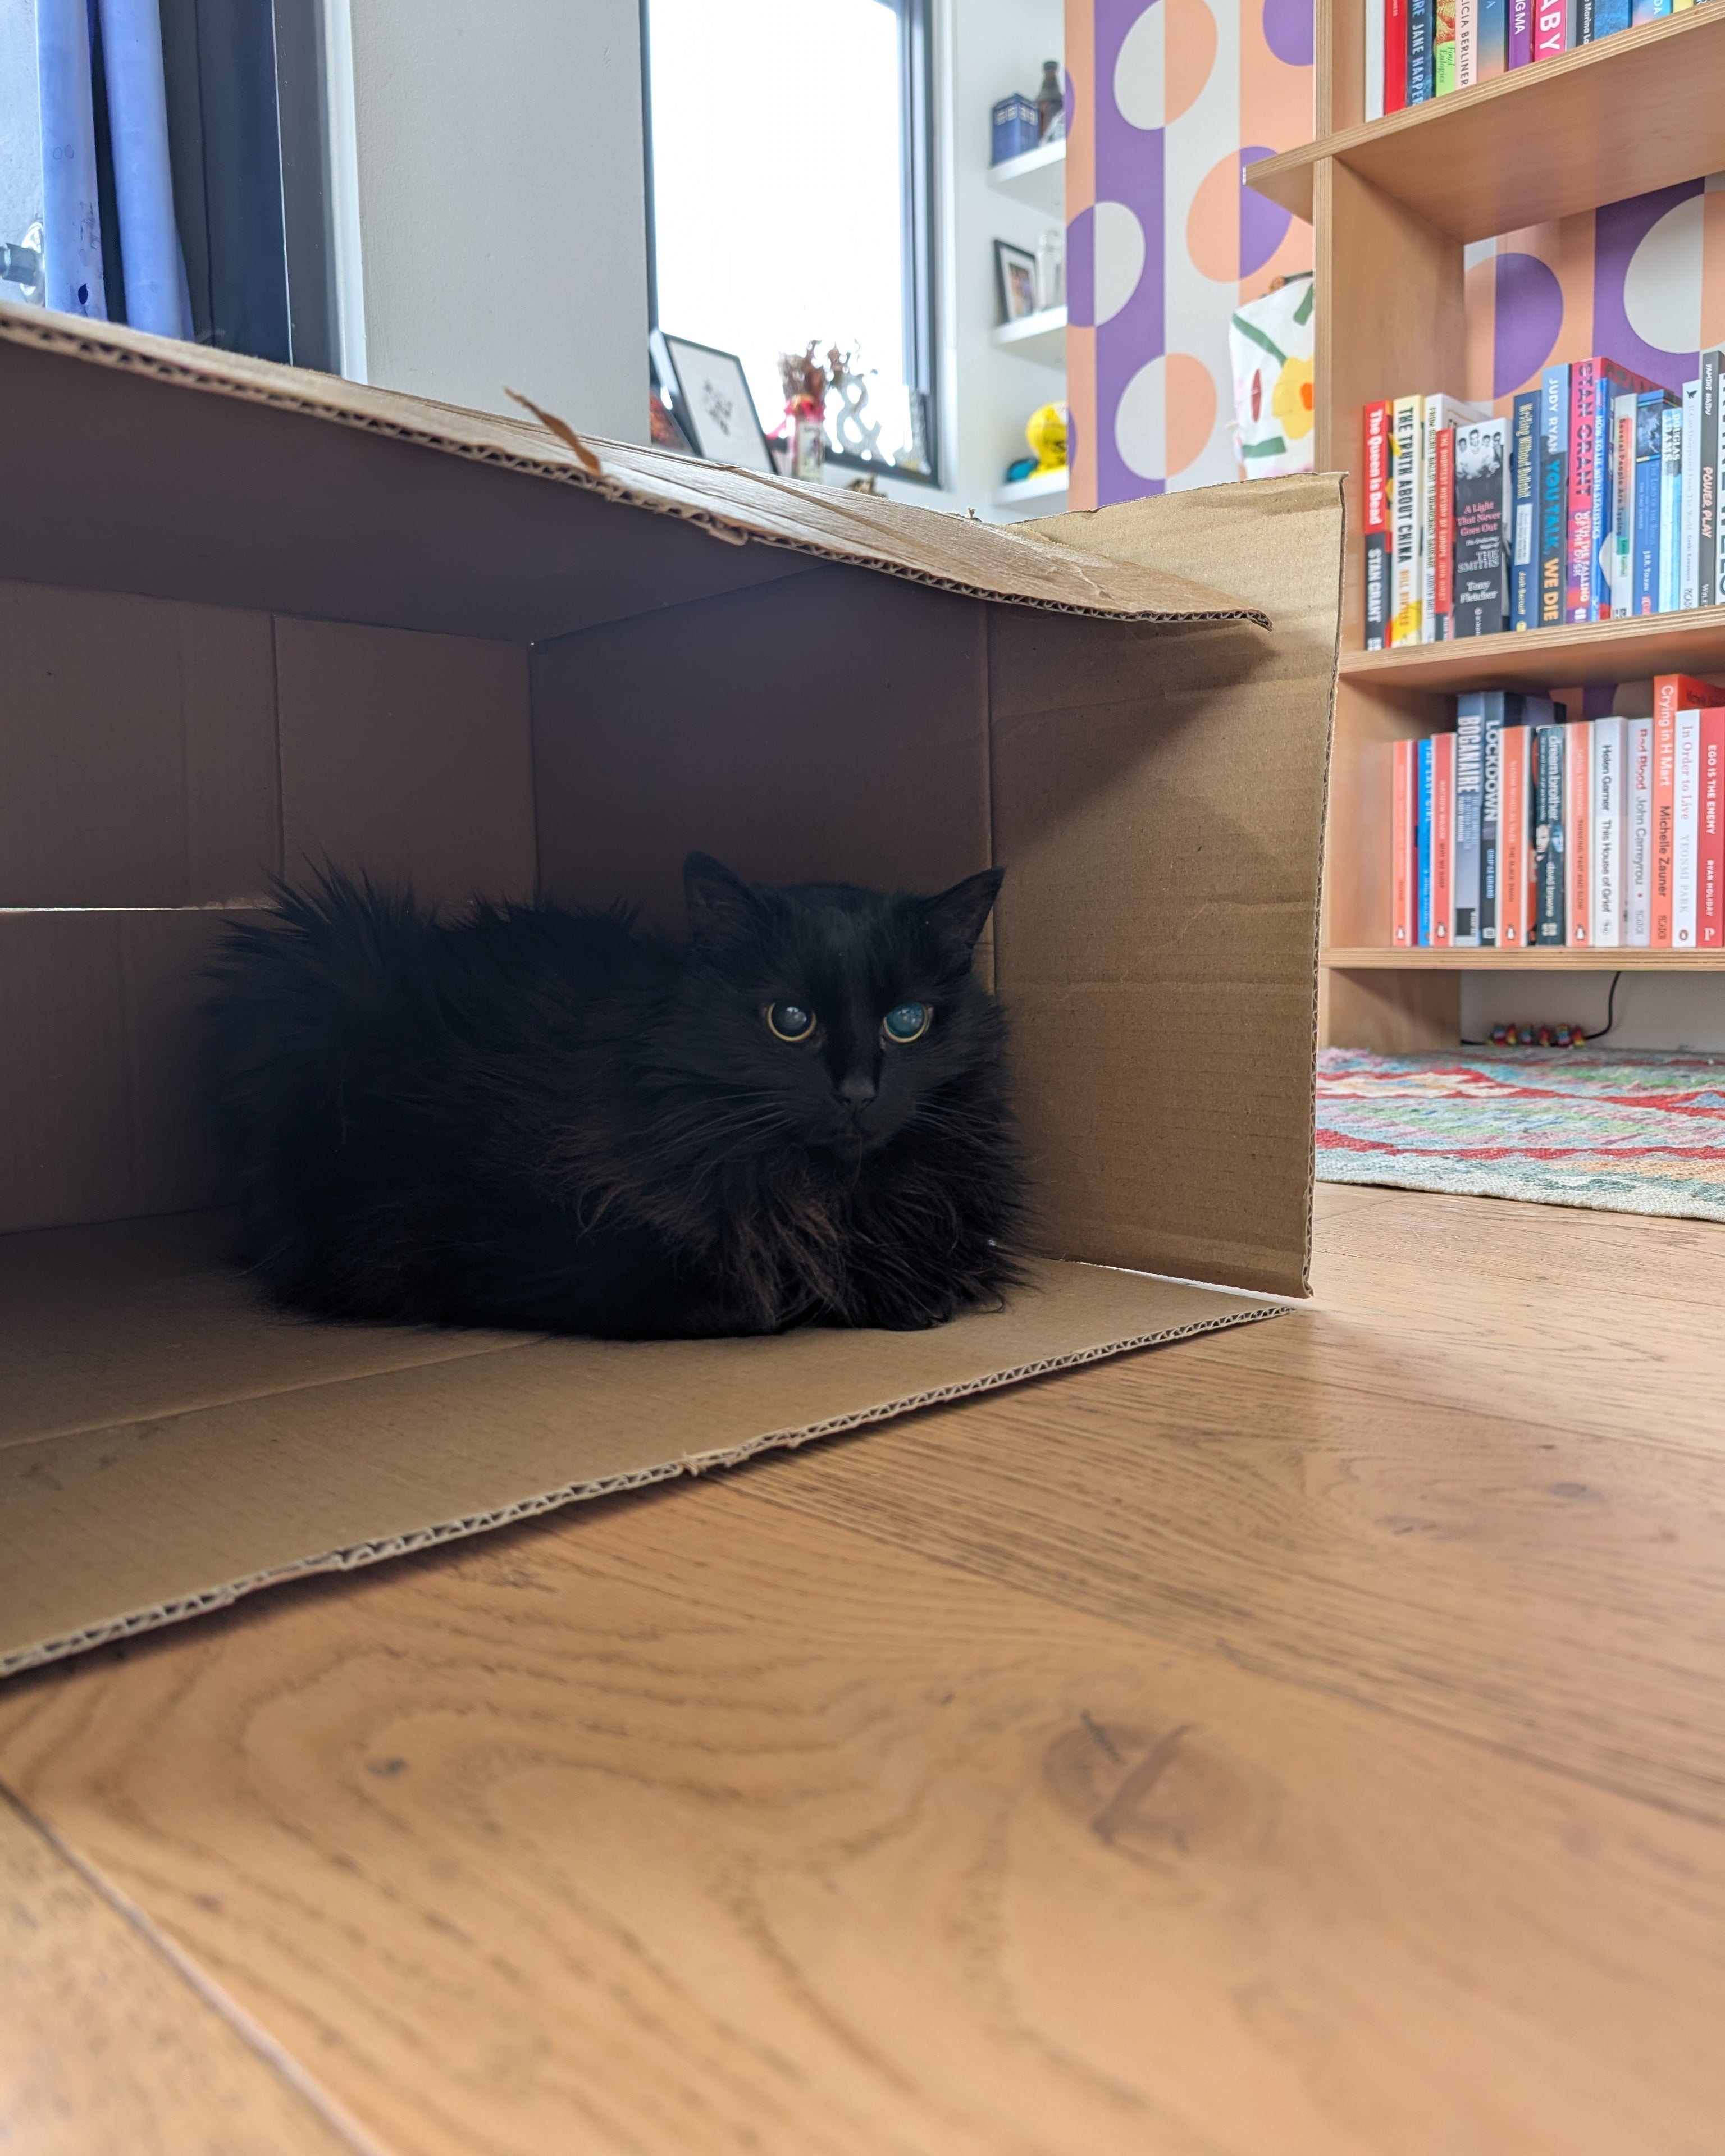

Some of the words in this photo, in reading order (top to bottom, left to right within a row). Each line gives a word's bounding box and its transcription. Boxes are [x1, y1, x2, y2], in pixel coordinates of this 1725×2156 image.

[1461, 0, 1470, 28] ICIA
[1583, 3, 1592, 34] Marina
[1412, 24, 1425, 54] JANE
[1438, 49, 1448, 83] Eulogies
[1447, 47, 1456, 66] Fowl
[1460, 31, 1470, 85] BERLINER
[1548, 378, 1559, 412] JUDY
[1578, 363, 1593, 417] STAN
[1370, 409, 1383, 435] The
[1398, 407, 1413, 432] THE
[1516, 403, 1533, 437] Writing
[1595, 415, 1604, 437] HOW
[1518, 435, 1532, 467] Without
[1548, 417, 1558, 455] RYAN
[1595, 440, 1603, 451] TO
[1663, 415, 1673, 462] ADAMS
[1672, 413, 1681, 461] DOUGLAS
[1368, 436, 1383, 478] Queen
[1398, 435, 1413, 476] TRUTH
[1576, 424, 1592, 496] GRANT
[1517, 466, 1532, 499] Bullshit
[1545, 459, 1560, 501] YOU
[1702, 467, 1714, 508] POWER
[1369, 491, 1383, 525] Dead
[1398, 481, 1413, 520] ABOUT
[1464, 505, 1471, 514] A
[1472, 501, 1494, 513] Light
[1592, 491, 1601, 540] STATISTICS
[1457, 515, 1476, 526] That
[1477, 511, 1502, 522] Never
[1460, 526, 1481, 536] Goes
[1481, 523, 1498, 532] Out
[1581, 511, 1591, 537] WITH
[1616, 506, 1624, 536] Typing
[1701, 509, 1713, 538] PLAY
[1398, 524, 1413, 564] CHINA
[1368, 548, 1382, 581] STAN
[1544, 558, 1559, 588] WE
[1460, 590, 1498, 604] Fletcher
[1466, 580, 1491, 591] Tony
[1580, 561, 1590, 602] FALLING
[1368, 581, 1382, 623] GRANT
[1543, 591, 1559, 622] DIE
[1658, 685, 1674, 727] Crying
[1639, 728, 1649, 752] Bad
[1660, 730, 1673, 741] in
[1682, 725, 1693, 738] In
[1458, 715, 1482, 793] BOGANAIRE
[1548, 736, 1563, 775] dream
[1602, 744, 1612, 774] Helen
[1660, 744, 1673, 753] H
[1681, 742, 1693, 776] Order
[1707, 744, 1717, 766] EGO
[1484, 720, 1500, 822] LOCKDOWN
[1636, 755, 1648, 791] Blood
[1660, 756, 1673, 787] Mart
[1681, 779, 1691, 792] to
[1707, 768, 1717, 778] IS
[1548, 775, 1561, 821] brother
[1602, 776, 1612, 811] Garner
[1707, 779, 1717, 799] THE
[1635, 797, 1647, 825] John
[1681, 795, 1692, 820] Live
[1706, 801, 1717, 834] ENEMY
[1602, 820, 1612, 841] This
[1659, 806, 1671, 854] Michelle
[1602, 843, 1612, 874] House
[1633, 828, 1647, 885] Carreyrou
[1706, 860, 1715, 881] RYAN
[1546, 861, 1557, 885] david
[1602, 876, 1612, 887] of
[1658, 857, 1670, 897] Zauner
[1546, 885, 1556, 917] browne
[1602, 888, 1612, 913] Grief
[1705, 882, 1714, 916] HOLIDAY
